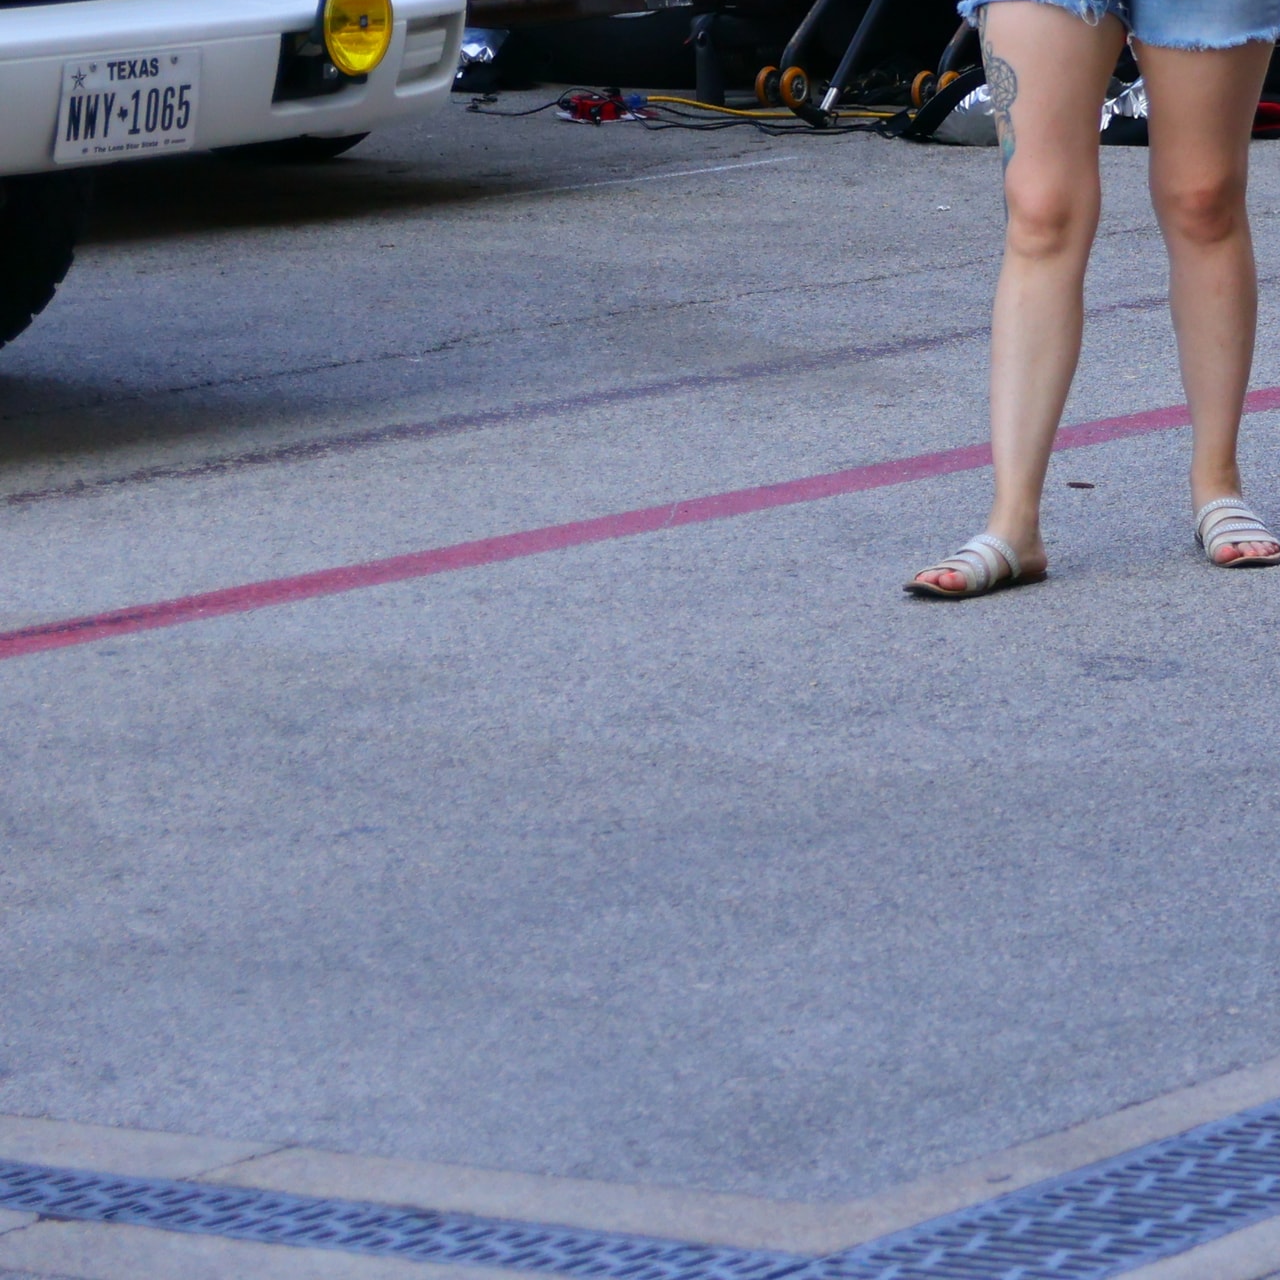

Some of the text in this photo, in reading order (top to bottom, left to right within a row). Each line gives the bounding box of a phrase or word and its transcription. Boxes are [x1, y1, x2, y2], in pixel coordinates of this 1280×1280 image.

[107, 57, 159, 81] TEXAS
[65, 84, 192, 141] NWY 1065
